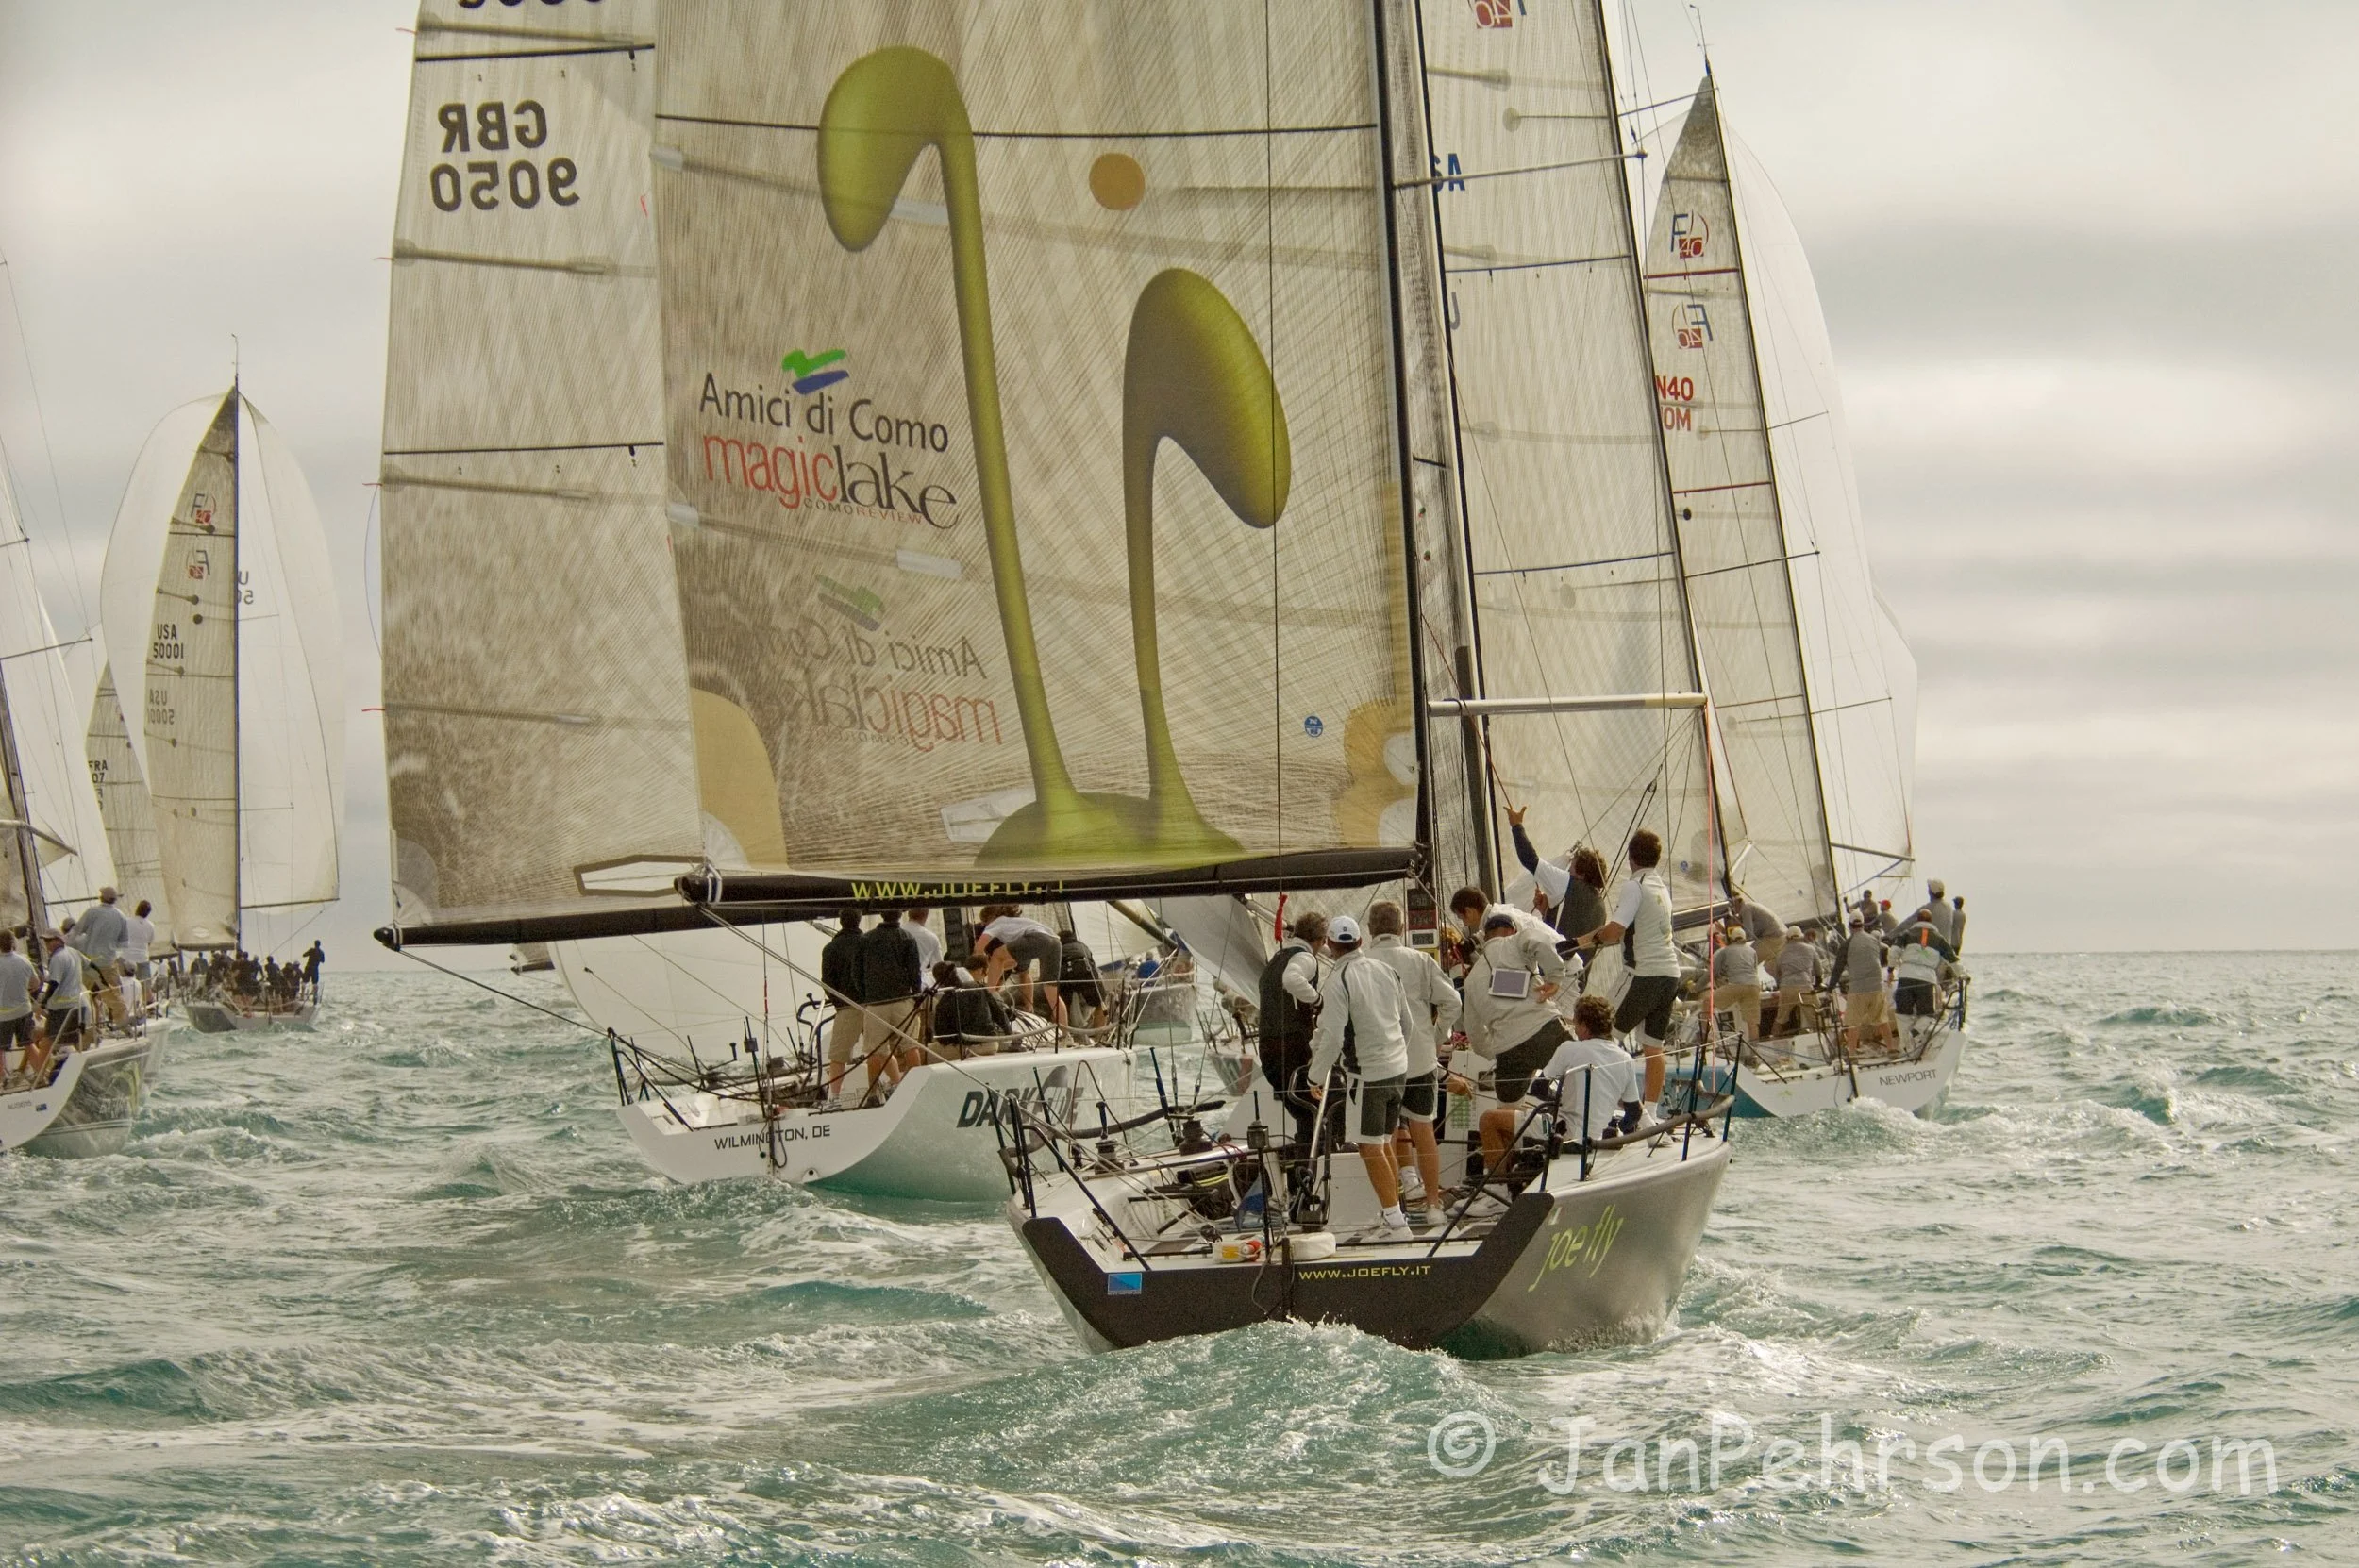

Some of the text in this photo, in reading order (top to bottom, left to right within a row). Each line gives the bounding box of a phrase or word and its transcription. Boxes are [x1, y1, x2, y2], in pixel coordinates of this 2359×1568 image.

[699, 372, 949, 454] Amici di Como
[702, 434, 961, 531] magiclake
[157, 623, 177, 640] USA
[153, 642, 184, 659] 50001
[1879, 1068, 1937, 1086] NEWPORT
[812, 1125, 830, 1138] DE
[1298, 1265, 1431, 1280] WWW.JOEFLY.IT
